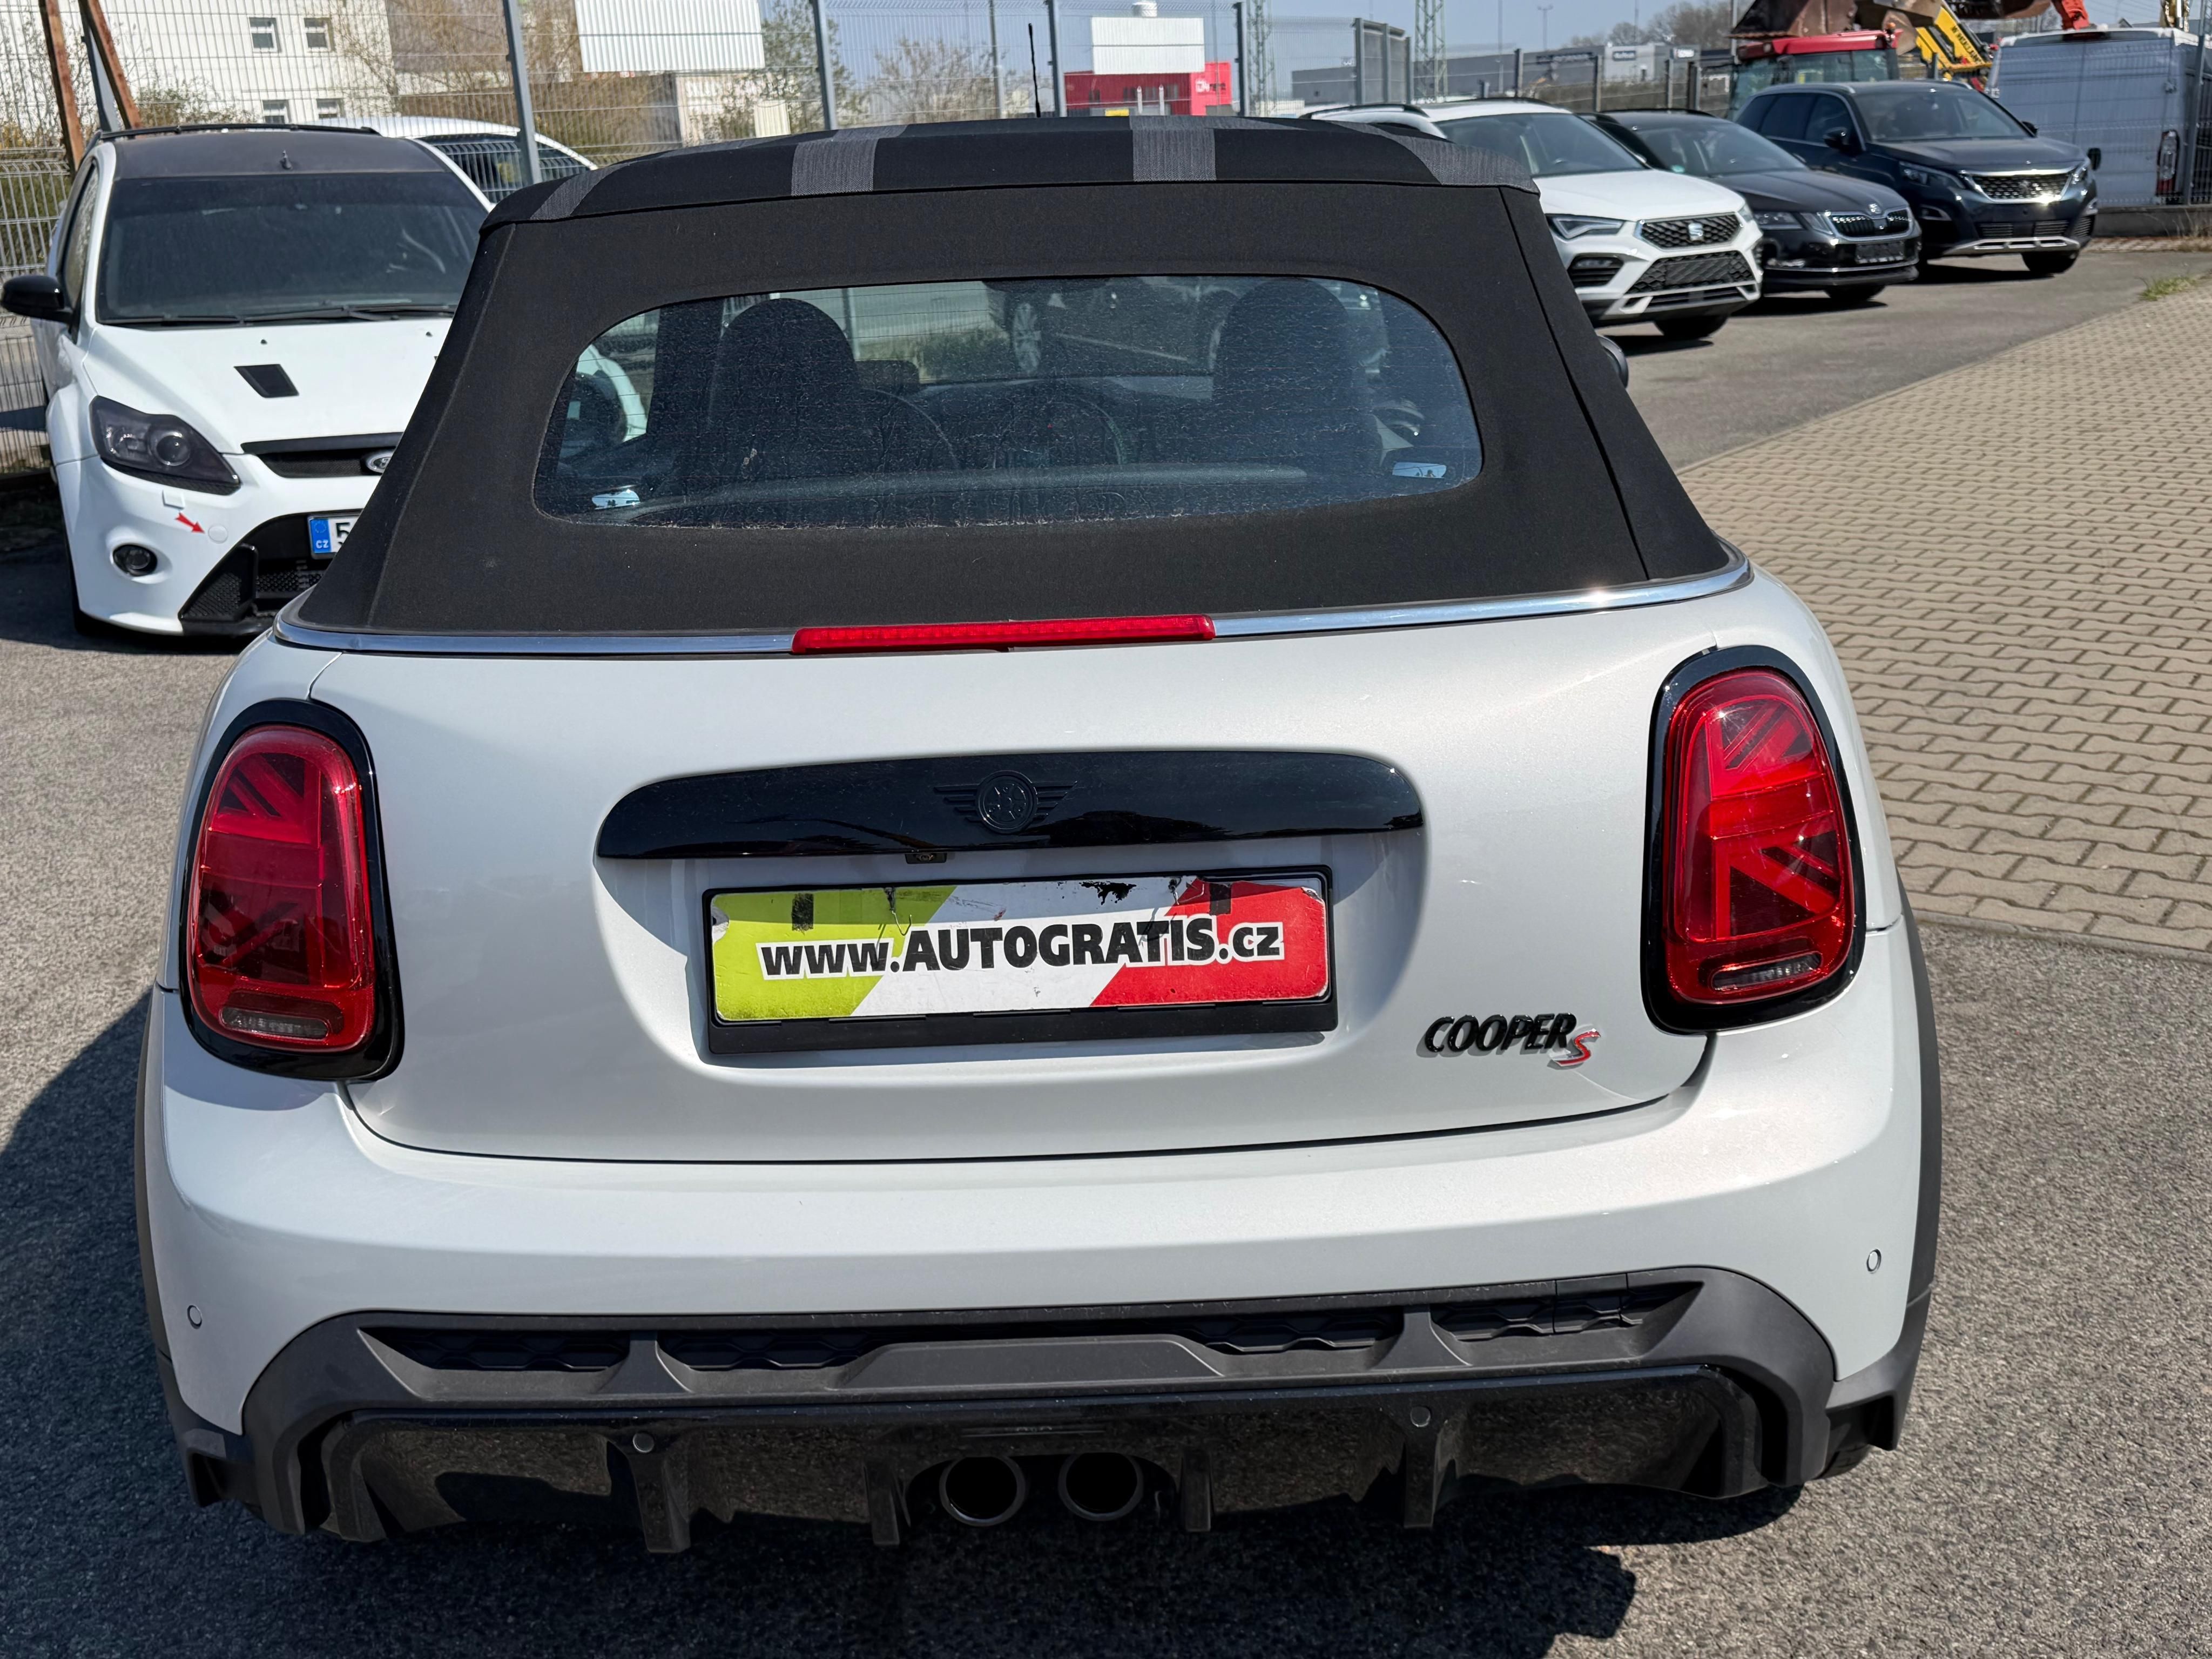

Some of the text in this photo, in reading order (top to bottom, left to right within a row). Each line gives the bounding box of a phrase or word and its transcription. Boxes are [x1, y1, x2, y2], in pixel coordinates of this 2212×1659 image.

[315, 540, 329, 549] CZ
[760, 917, 1280, 976] www.AUTOGRATIS.cz
[1425, 1012, 1577, 1053] COOPER
